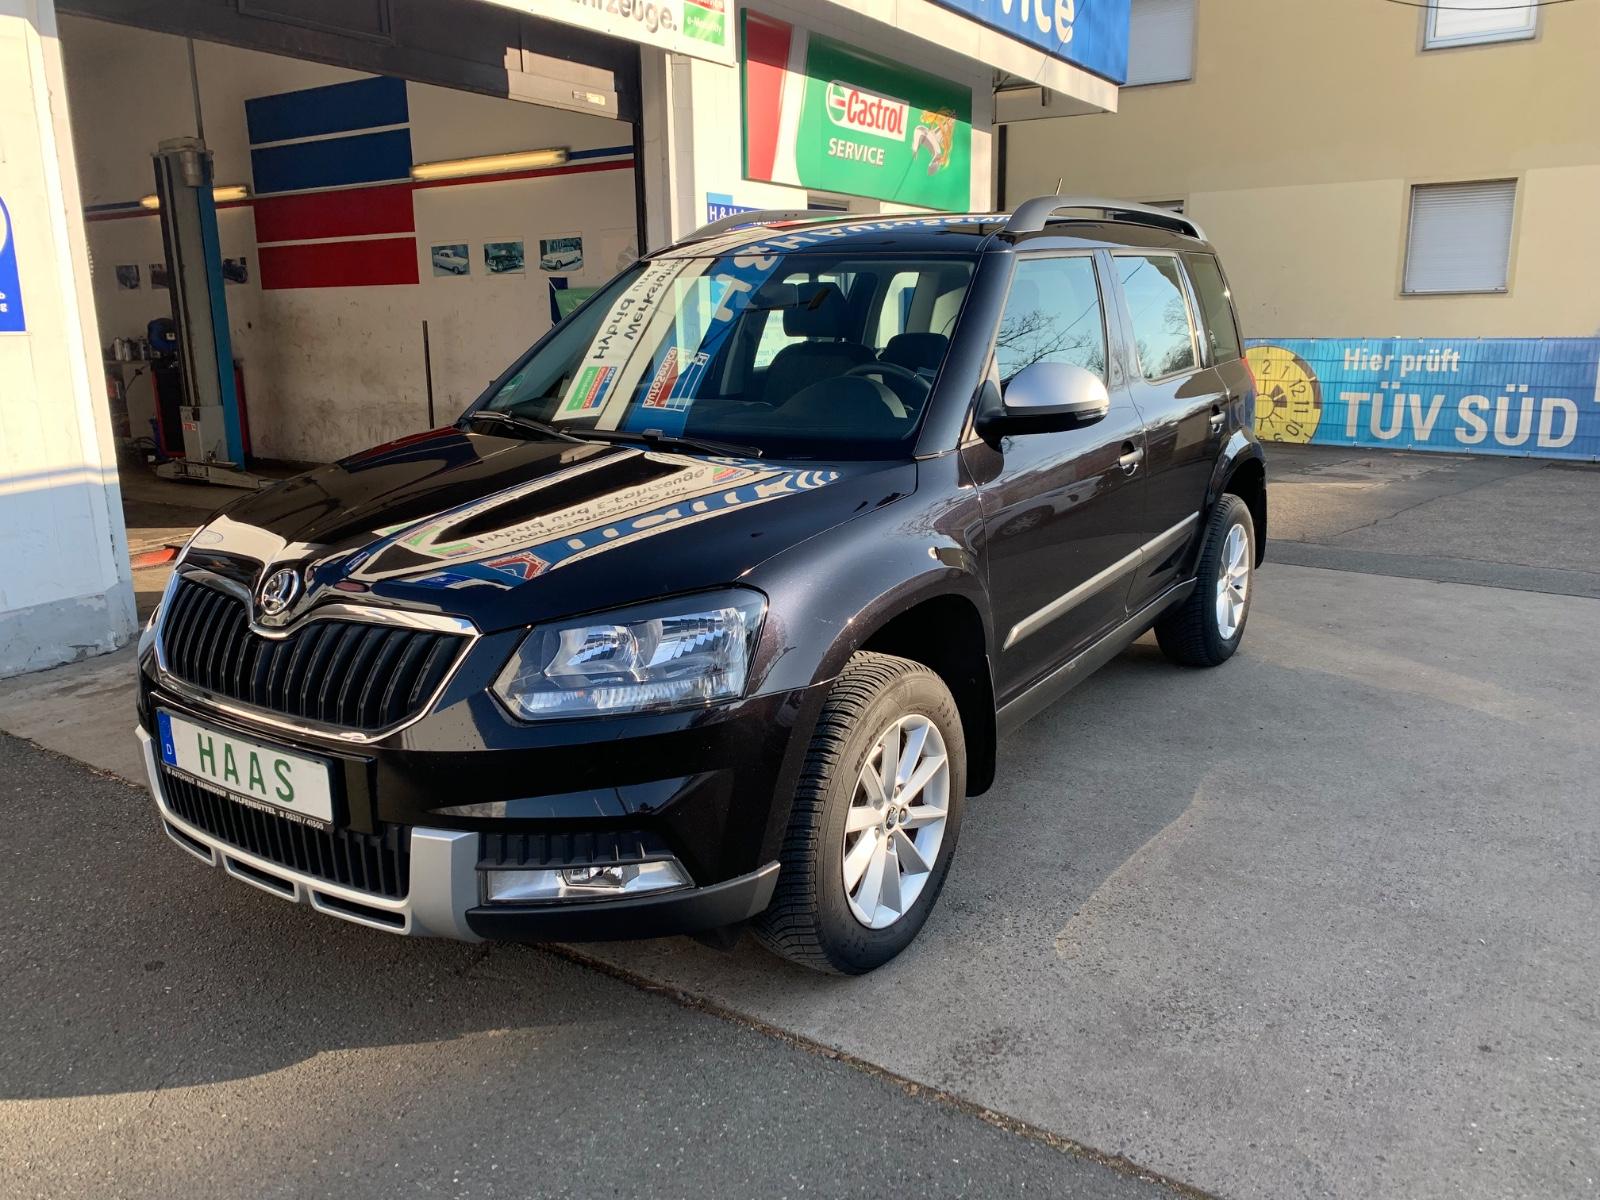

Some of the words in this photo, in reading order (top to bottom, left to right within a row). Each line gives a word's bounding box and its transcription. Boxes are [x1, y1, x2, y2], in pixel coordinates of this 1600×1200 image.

[847, 90, 903, 135] Castrol
[828, 137, 885, 166] SERVICE
[1262, 359, 1271, 375] 2
[1343, 347, 1394, 371] Hier
[1400, 348, 1460, 378] prüft
[1289, 379, 1307, 397] 12
[1294, 400, 1310, 413] 11
[1340, 381, 1446, 441] TÜV
[1454, 383, 1578, 448] SÜD
[166, 744, 173, 755] D
[171, 771, 195, 785] AUTOHAUS
[197, 731, 295, 803] HAAS
